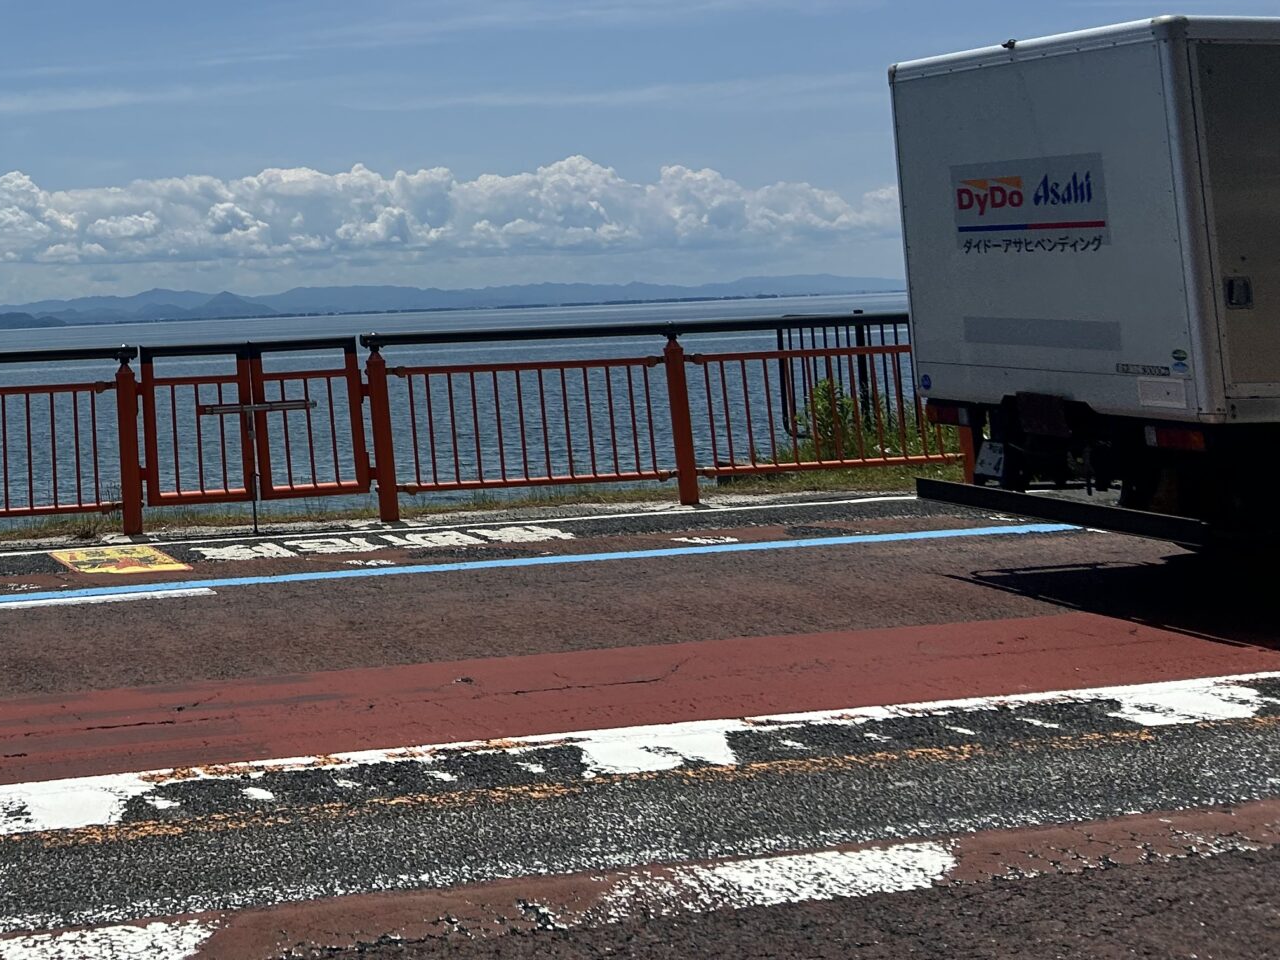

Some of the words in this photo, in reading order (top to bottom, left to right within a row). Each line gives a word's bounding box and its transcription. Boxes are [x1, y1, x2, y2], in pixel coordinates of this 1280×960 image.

[957, 186, 1024, 216] DyDo
[1033, 171, 1093, 206] Asahi
[963, 236, 1103, 254] ダイドーアサヒベンディング
